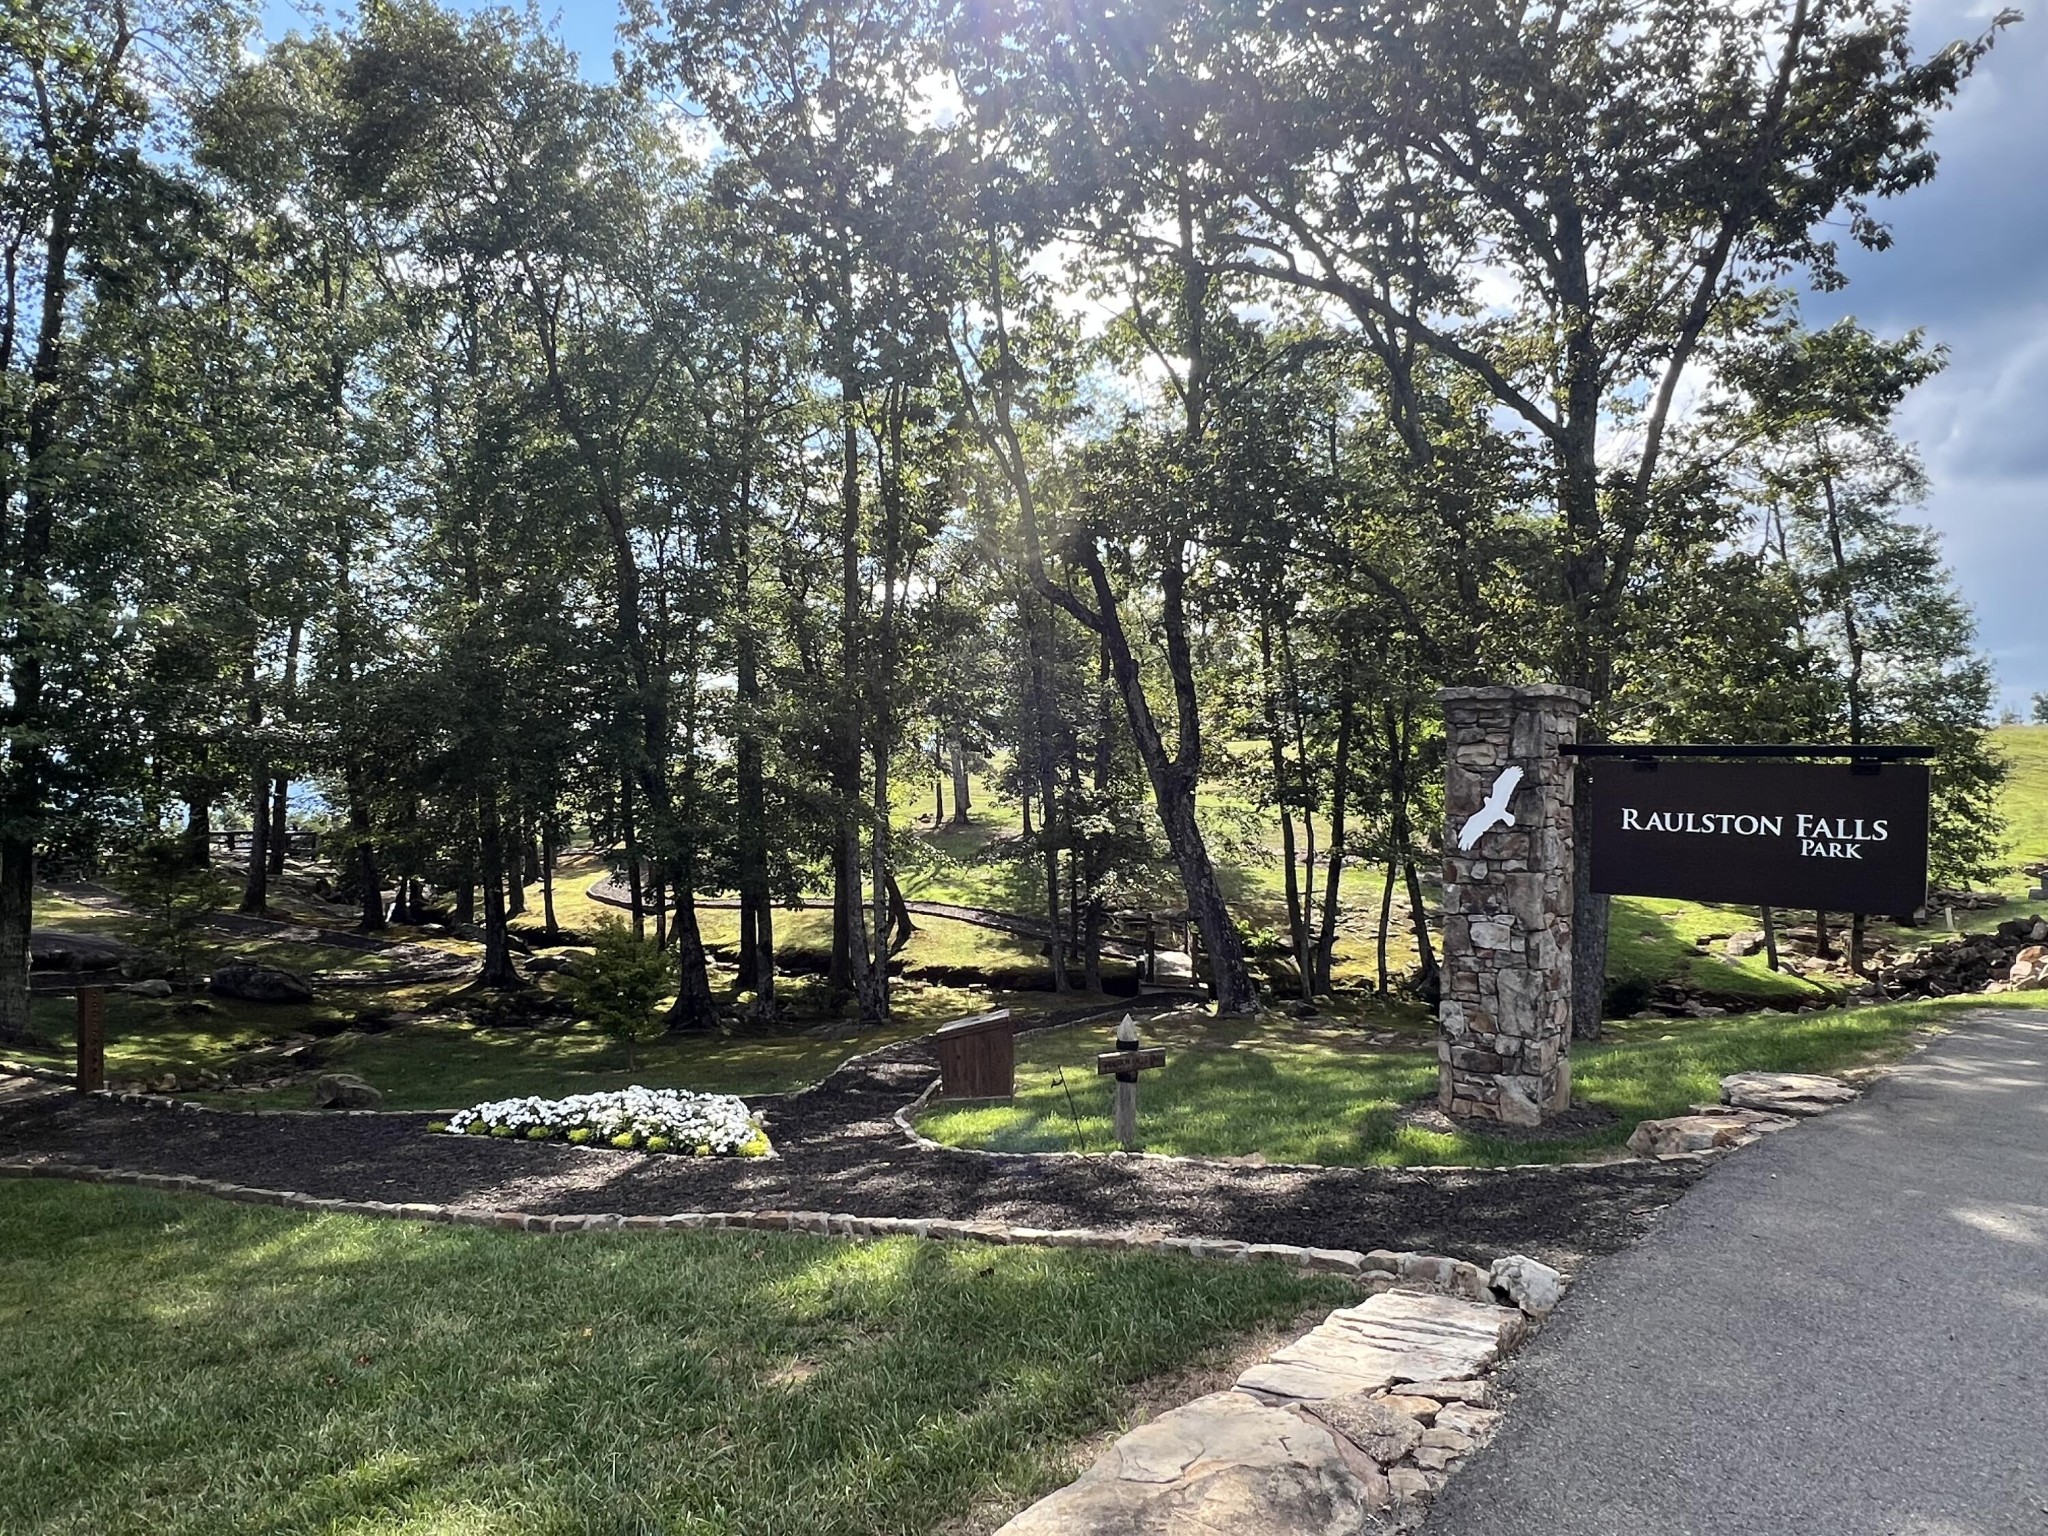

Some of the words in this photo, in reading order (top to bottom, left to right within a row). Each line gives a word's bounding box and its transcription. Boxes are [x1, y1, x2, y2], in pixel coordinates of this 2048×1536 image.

[1621, 807, 1784, 837] RAULSTON
[1796, 813, 1889, 841] FALLS
[1800, 838, 1864, 860] PARK
